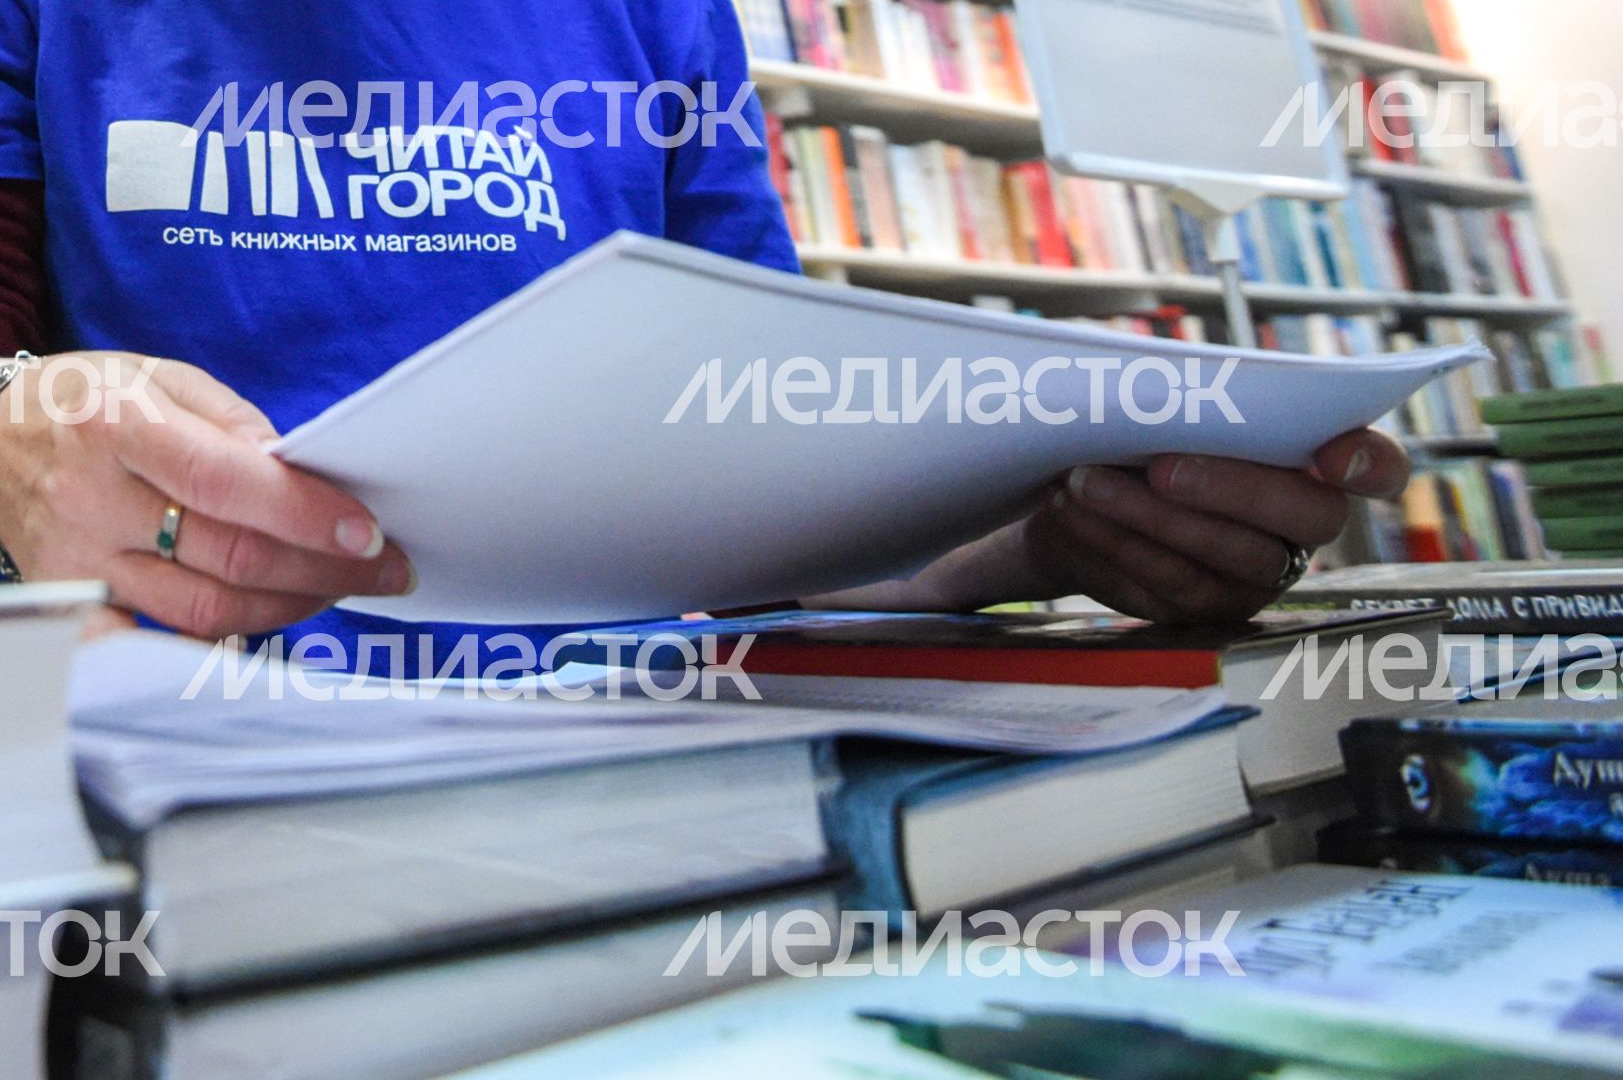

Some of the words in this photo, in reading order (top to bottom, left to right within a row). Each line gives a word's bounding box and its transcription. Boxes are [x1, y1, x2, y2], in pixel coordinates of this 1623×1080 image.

[345, 125, 553, 183] ЧИТАЙ
[347, 170, 566, 241] ГОРОД
[163, 226, 222, 246] сеть
[232, 231, 357, 252] книжных
[366, 232, 517, 252] магазинов
[1511, 595, 1529, 618] С
